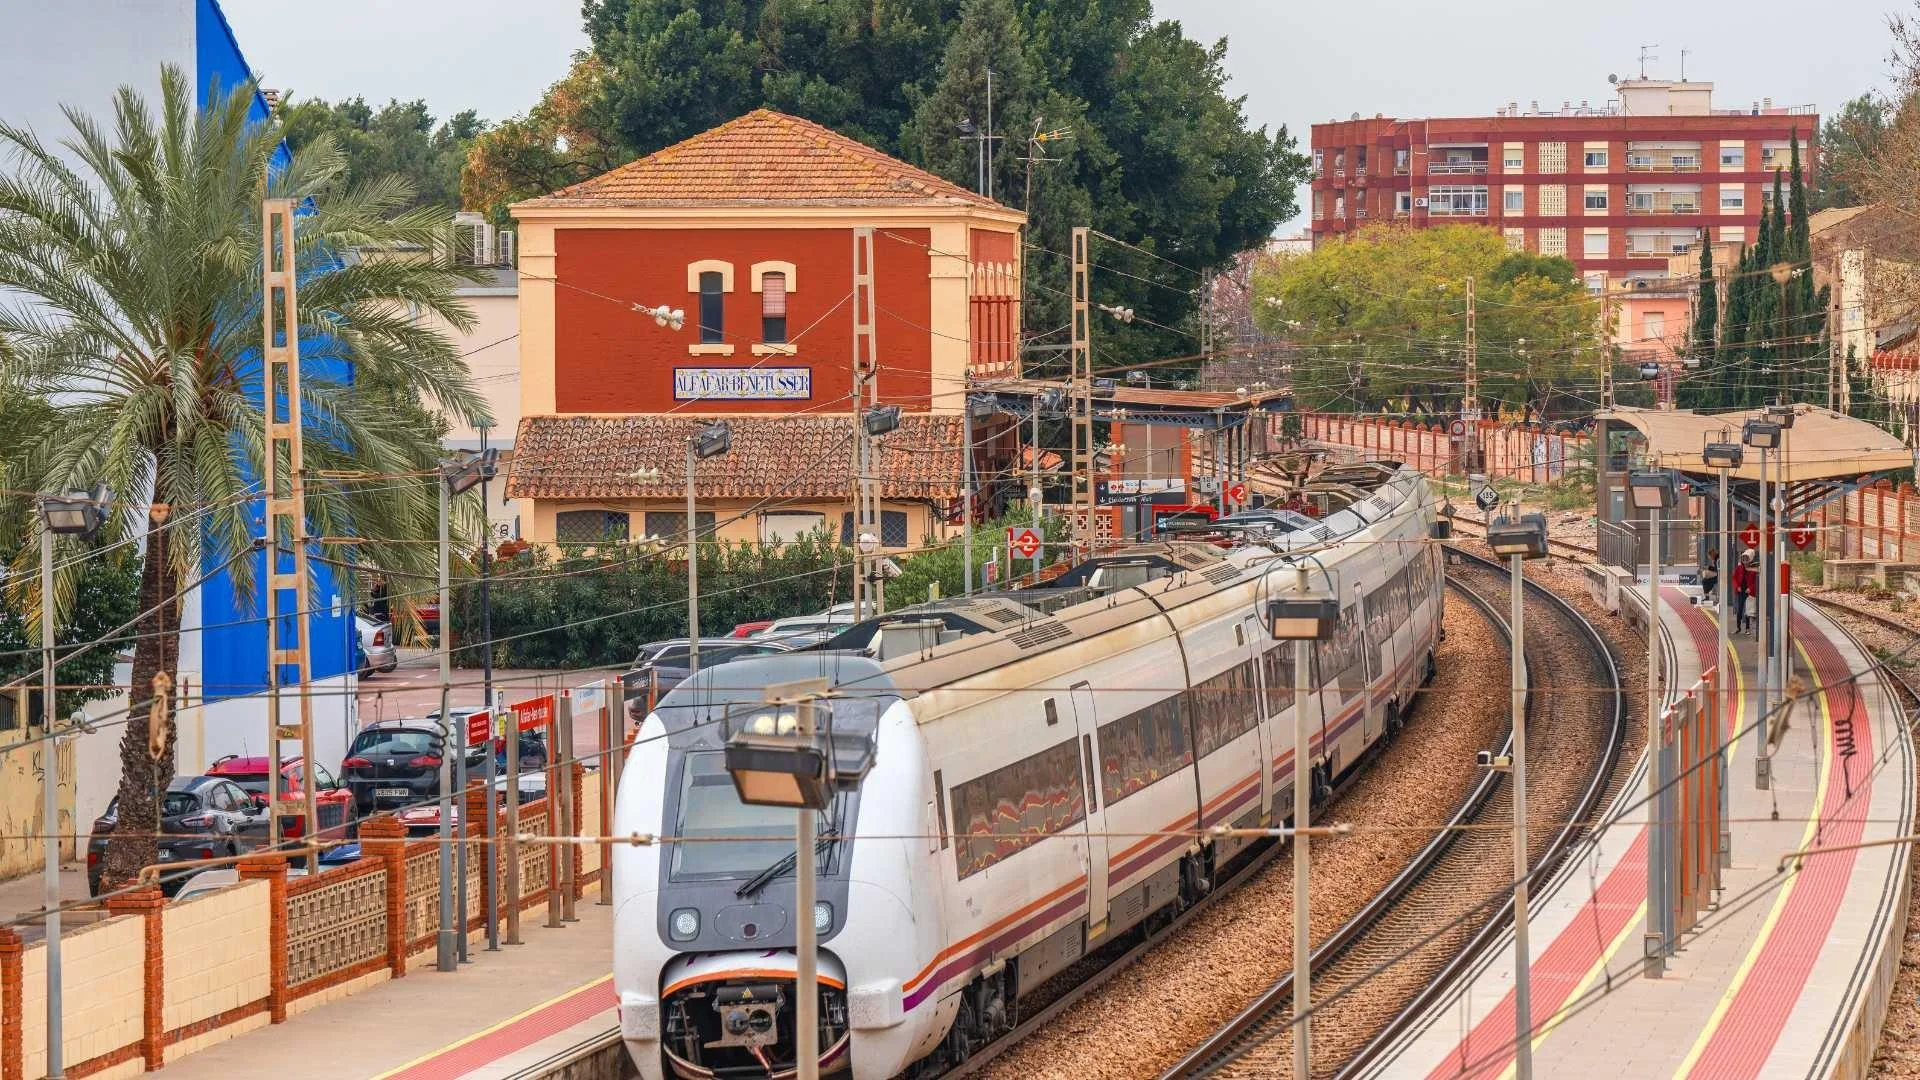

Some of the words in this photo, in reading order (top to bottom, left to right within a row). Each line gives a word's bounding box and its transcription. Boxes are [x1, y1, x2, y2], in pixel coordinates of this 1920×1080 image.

[676, 375, 809, 392] ALFAFAR-BENETUSSER
[1237, 486, 1244, 500] 2
[1024, 536, 1033, 551] 2
[1747, 529, 1757, 544] 1
[1796, 528, 1806, 544] 3
